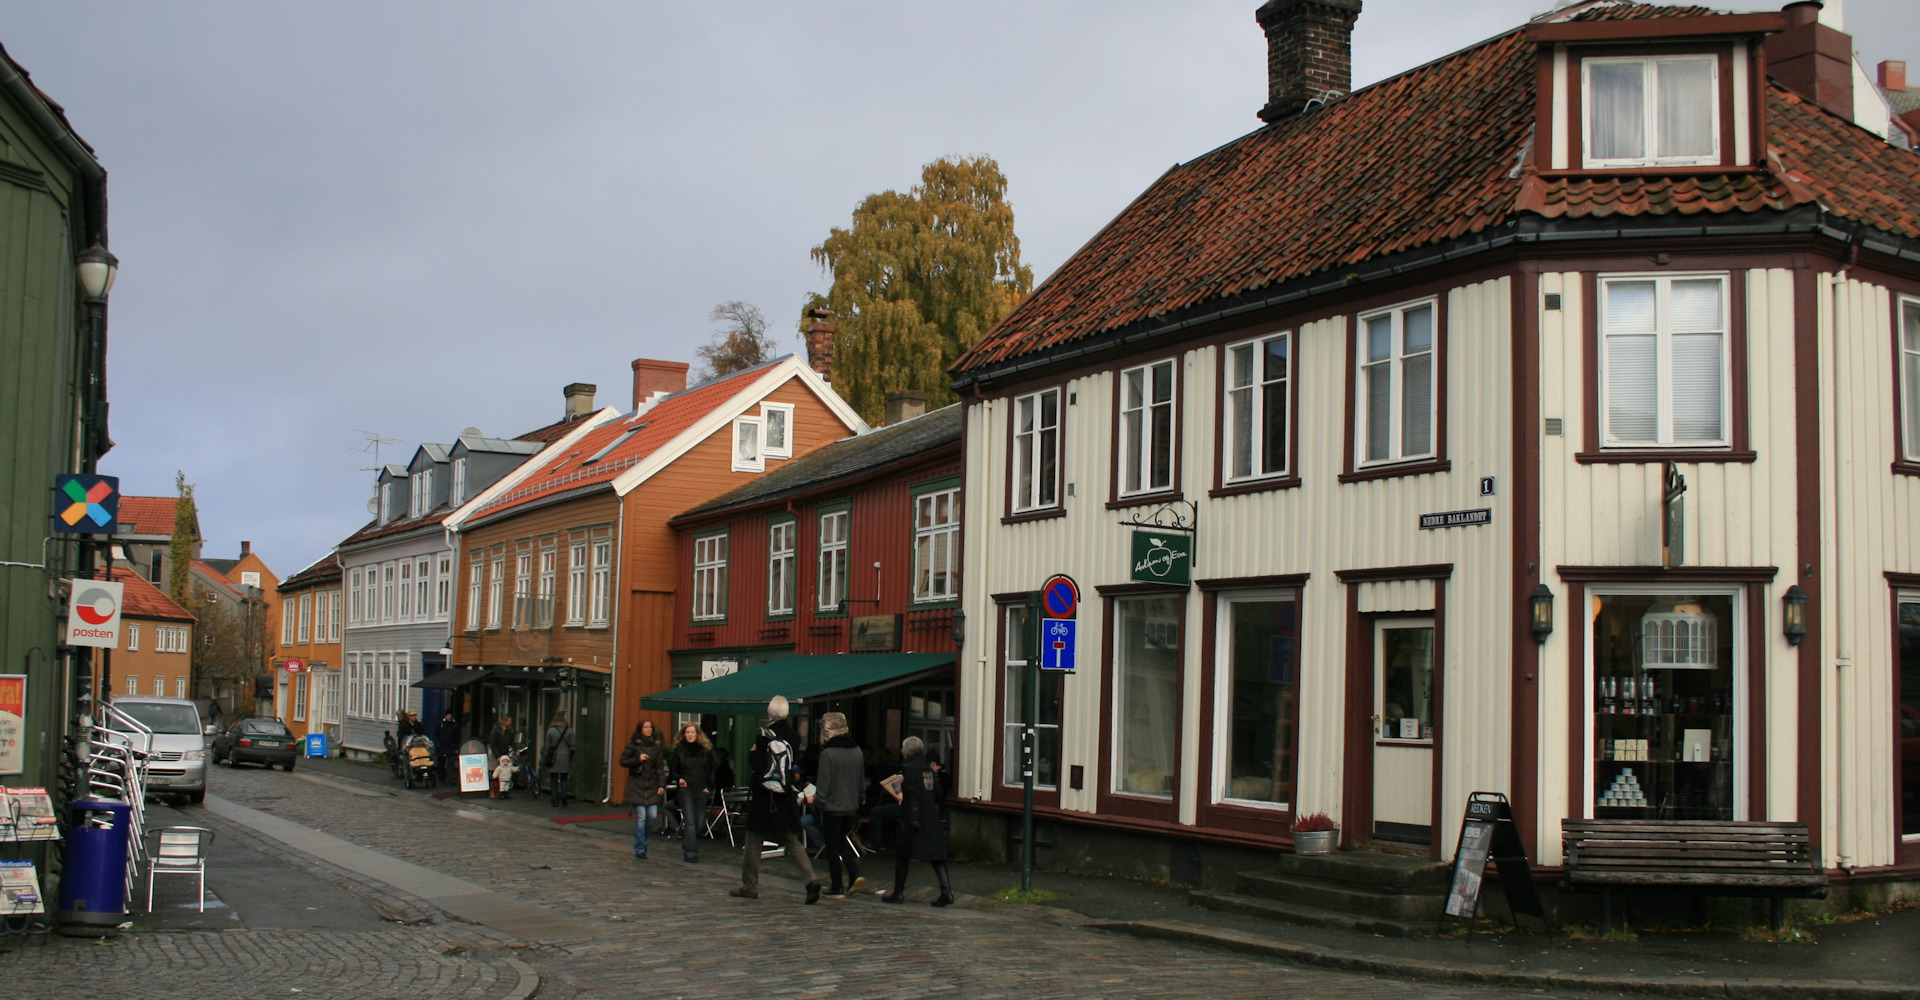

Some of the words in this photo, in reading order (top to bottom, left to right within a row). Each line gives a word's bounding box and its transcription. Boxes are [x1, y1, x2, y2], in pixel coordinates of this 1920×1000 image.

[1483, 480, 1489, 493] 1
[1423, 516, 1444, 526] NEDRE
[1448, 512, 1487, 524] BAKLANDET
[1135, 558, 1161, 572] Adam
[1162, 556, 1170, 565] og
[1171, 550, 1188, 560] Eva
[73, 628, 114, 638] posten
[1470, 803, 1491, 814] REDKEN
